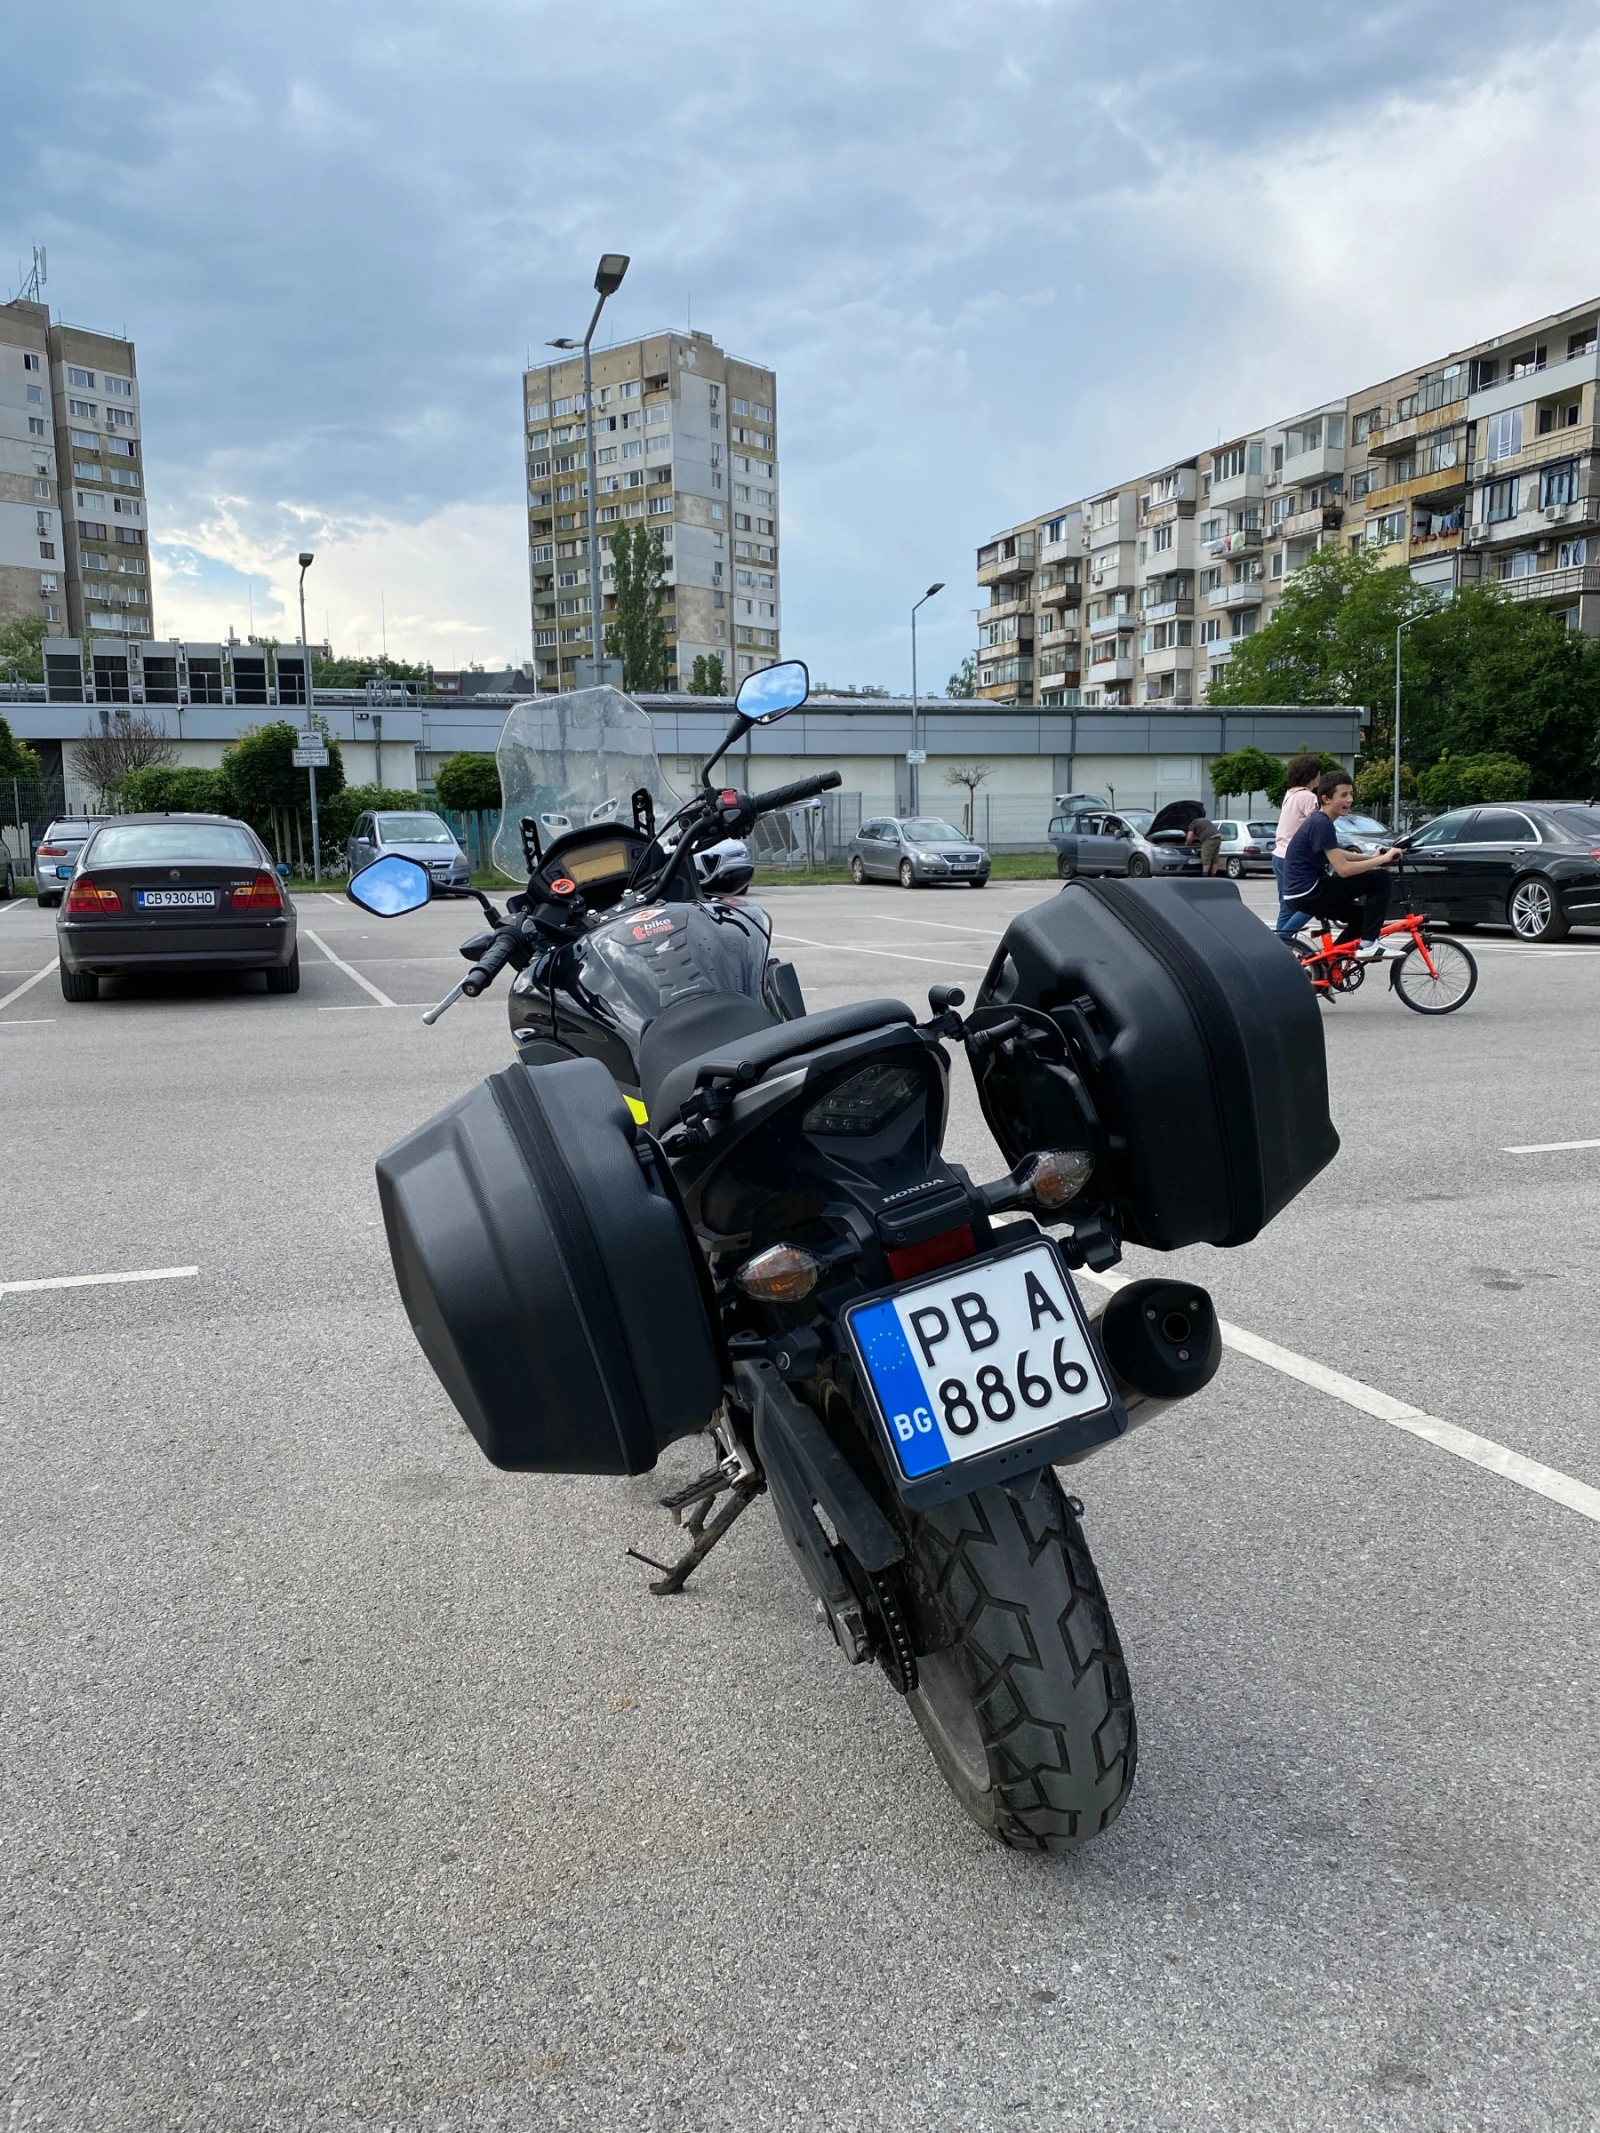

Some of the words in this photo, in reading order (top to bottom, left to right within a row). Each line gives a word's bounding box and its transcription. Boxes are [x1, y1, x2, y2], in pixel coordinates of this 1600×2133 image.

[146, 893, 162, 904] CB
[164, 893, 194, 904] 9306
[196, 892, 212, 904] HO
[882, 1179, 945, 1203] HONDA
[908, 1291, 1000, 1368] PB
[1023, 1270, 1065, 1331] A
[938, 1336, 1089, 1436] 8866
[893, 1406, 933, 1442] BG
